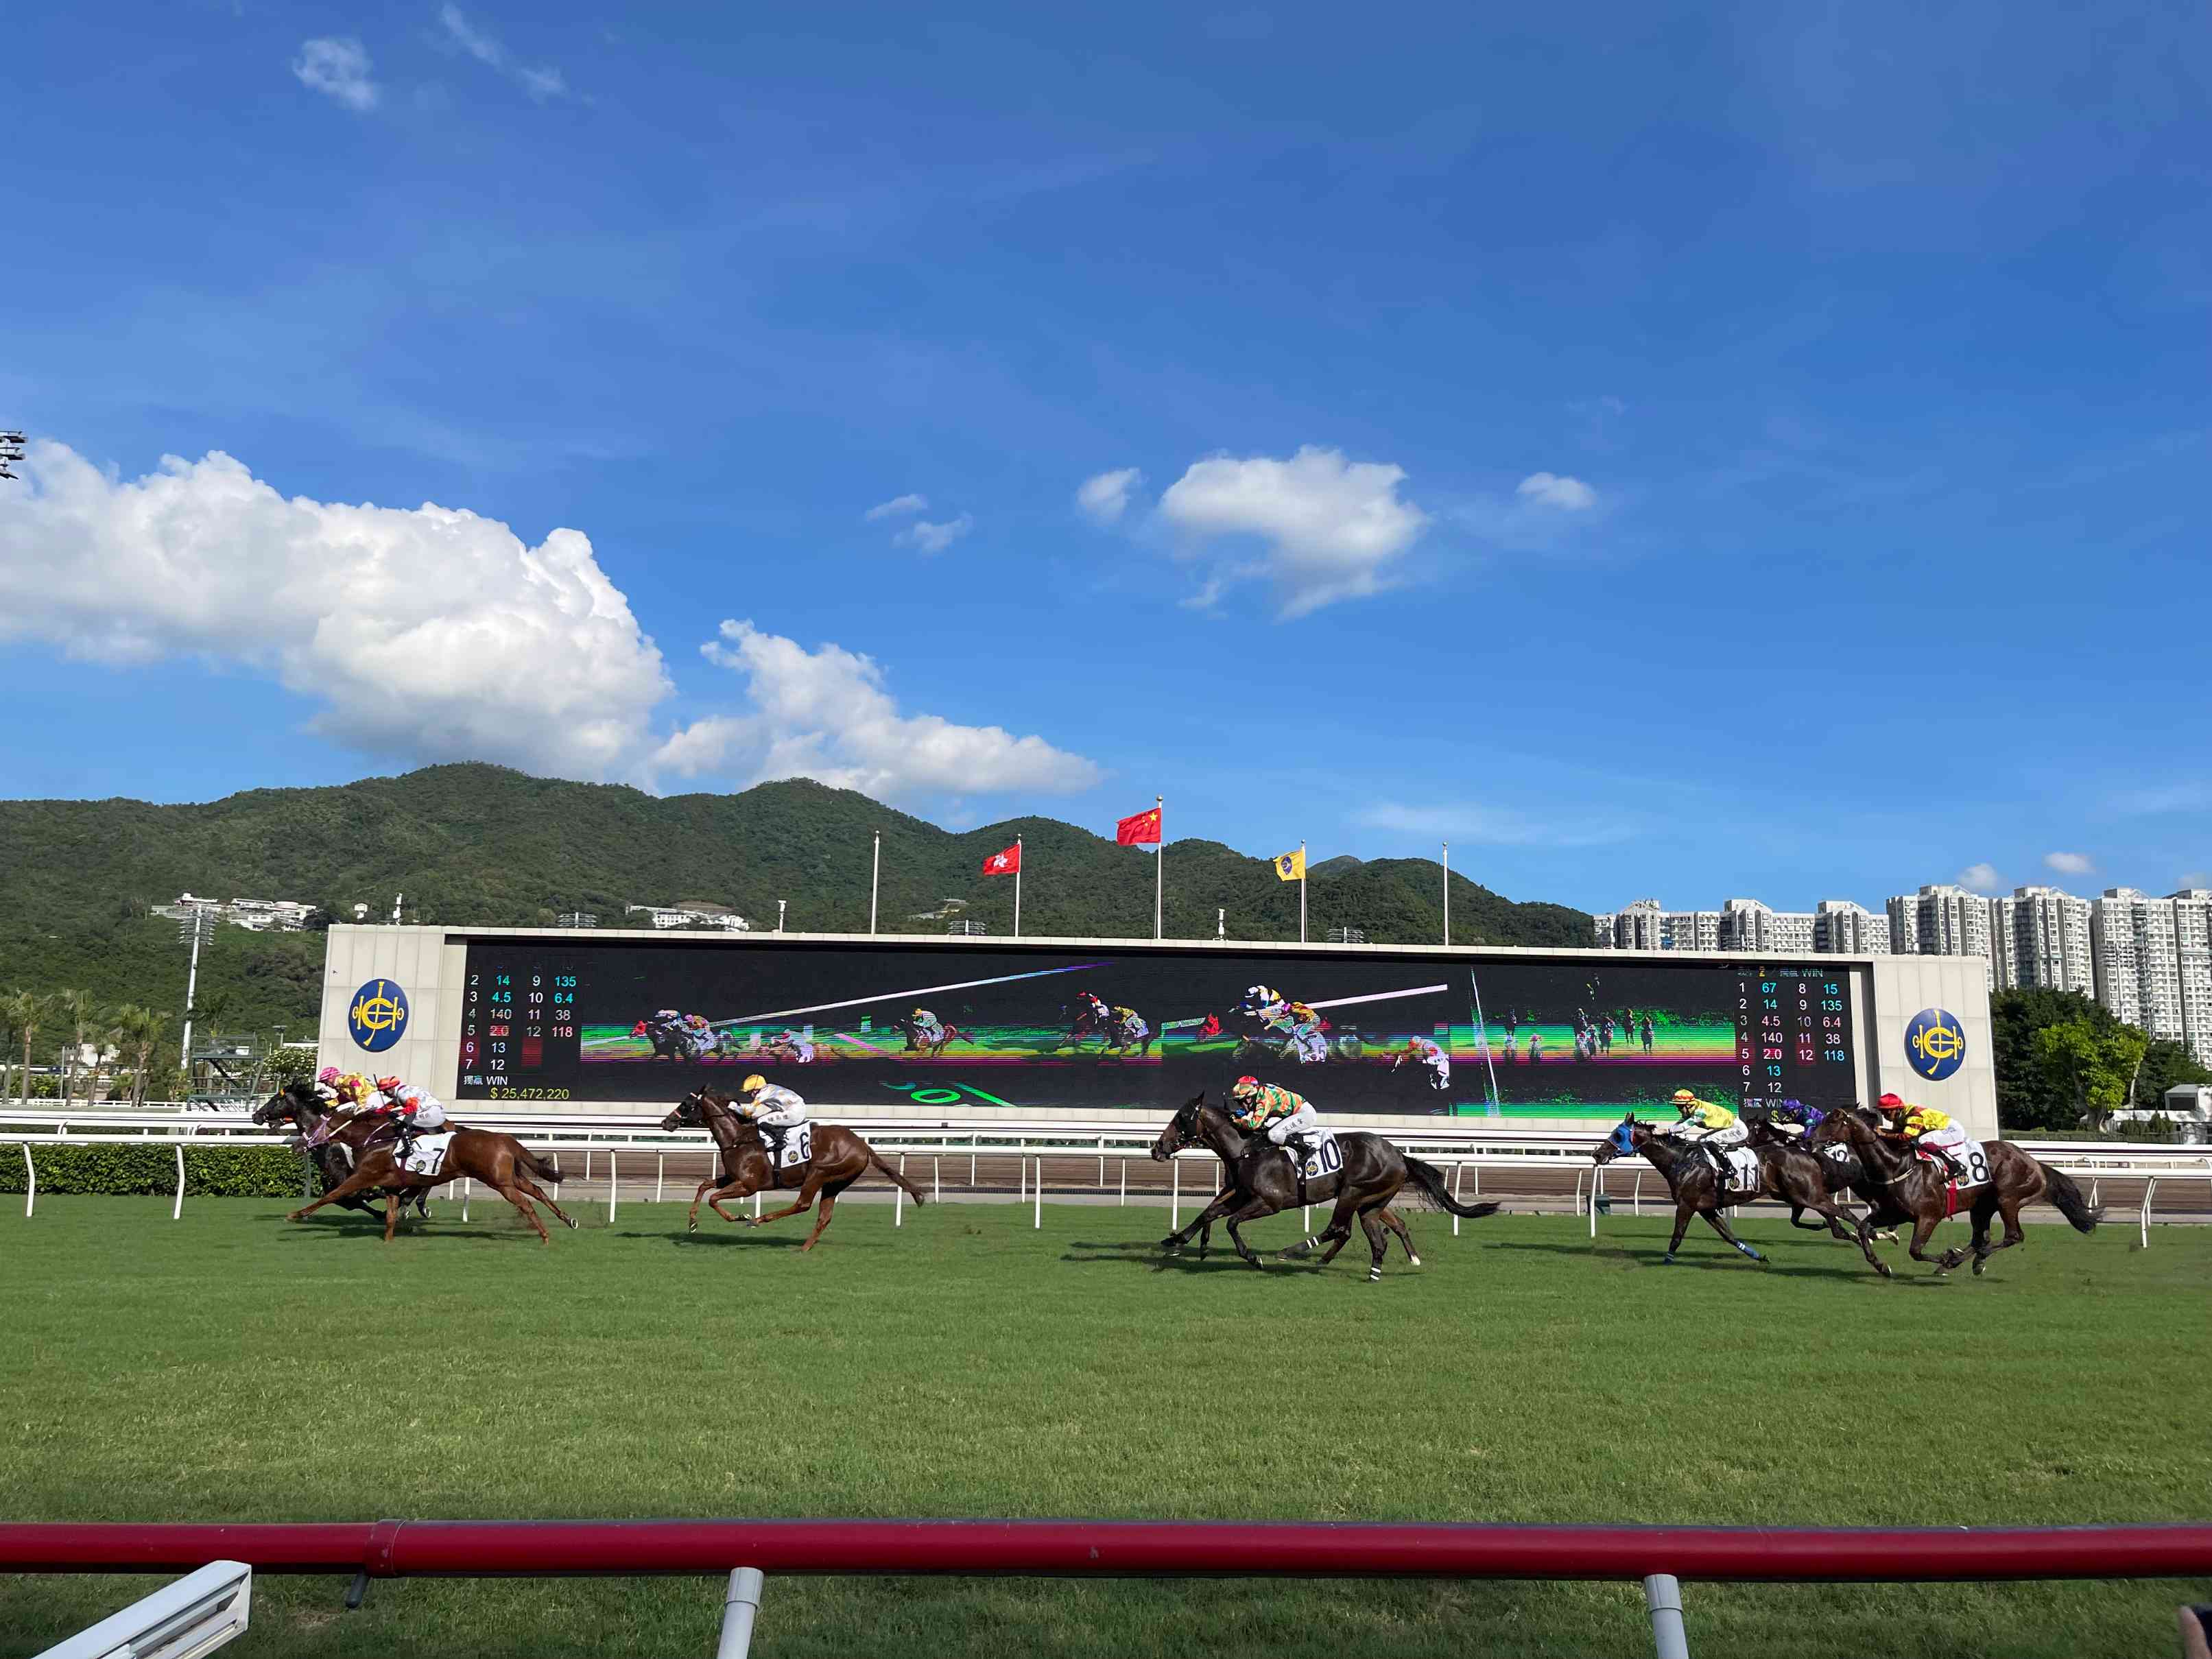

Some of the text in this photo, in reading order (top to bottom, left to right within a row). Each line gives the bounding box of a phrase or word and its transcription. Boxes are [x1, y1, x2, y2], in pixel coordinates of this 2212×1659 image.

[471, 975, 577, 987] 2 14 9 135
[1739, 982, 1838, 994] 1 67 8 15
[470, 991, 573, 1004] 3 4.5 10 6.4
[1739, 999, 1842, 1011] 2 14 9 135
[468, 1008, 571, 1021] 4 140 11 38
[1740, 1015, 1842, 1027] 3 4.5 10 6.4
[467, 1025, 475, 1036] 5
[527, 1026, 541, 1037] 12
[552, 1026, 573, 1038] 118
[1741, 1031, 1840, 1044] 4 140 11 38
[466, 1042, 506, 1053] 6 13
[1741, 1049, 1844, 1061] 5 2.0 12 118
[466, 1059, 505, 1071] 7 12
[1742, 1065, 1781, 1076] 6 13
[486, 1075, 508, 1086] WIN
[1744, 1082, 1782, 1093] 7 12
[800, 1132, 809, 1159] 6
[433, 1147, 445, 1174] 7
[1316, 1139, 1341, 1172] 10
[1831, 1150, 1847, 1163] 12
[1969, 1151, 1989, 1182] 8
[1741, 1163, 1759, 1191] 11
